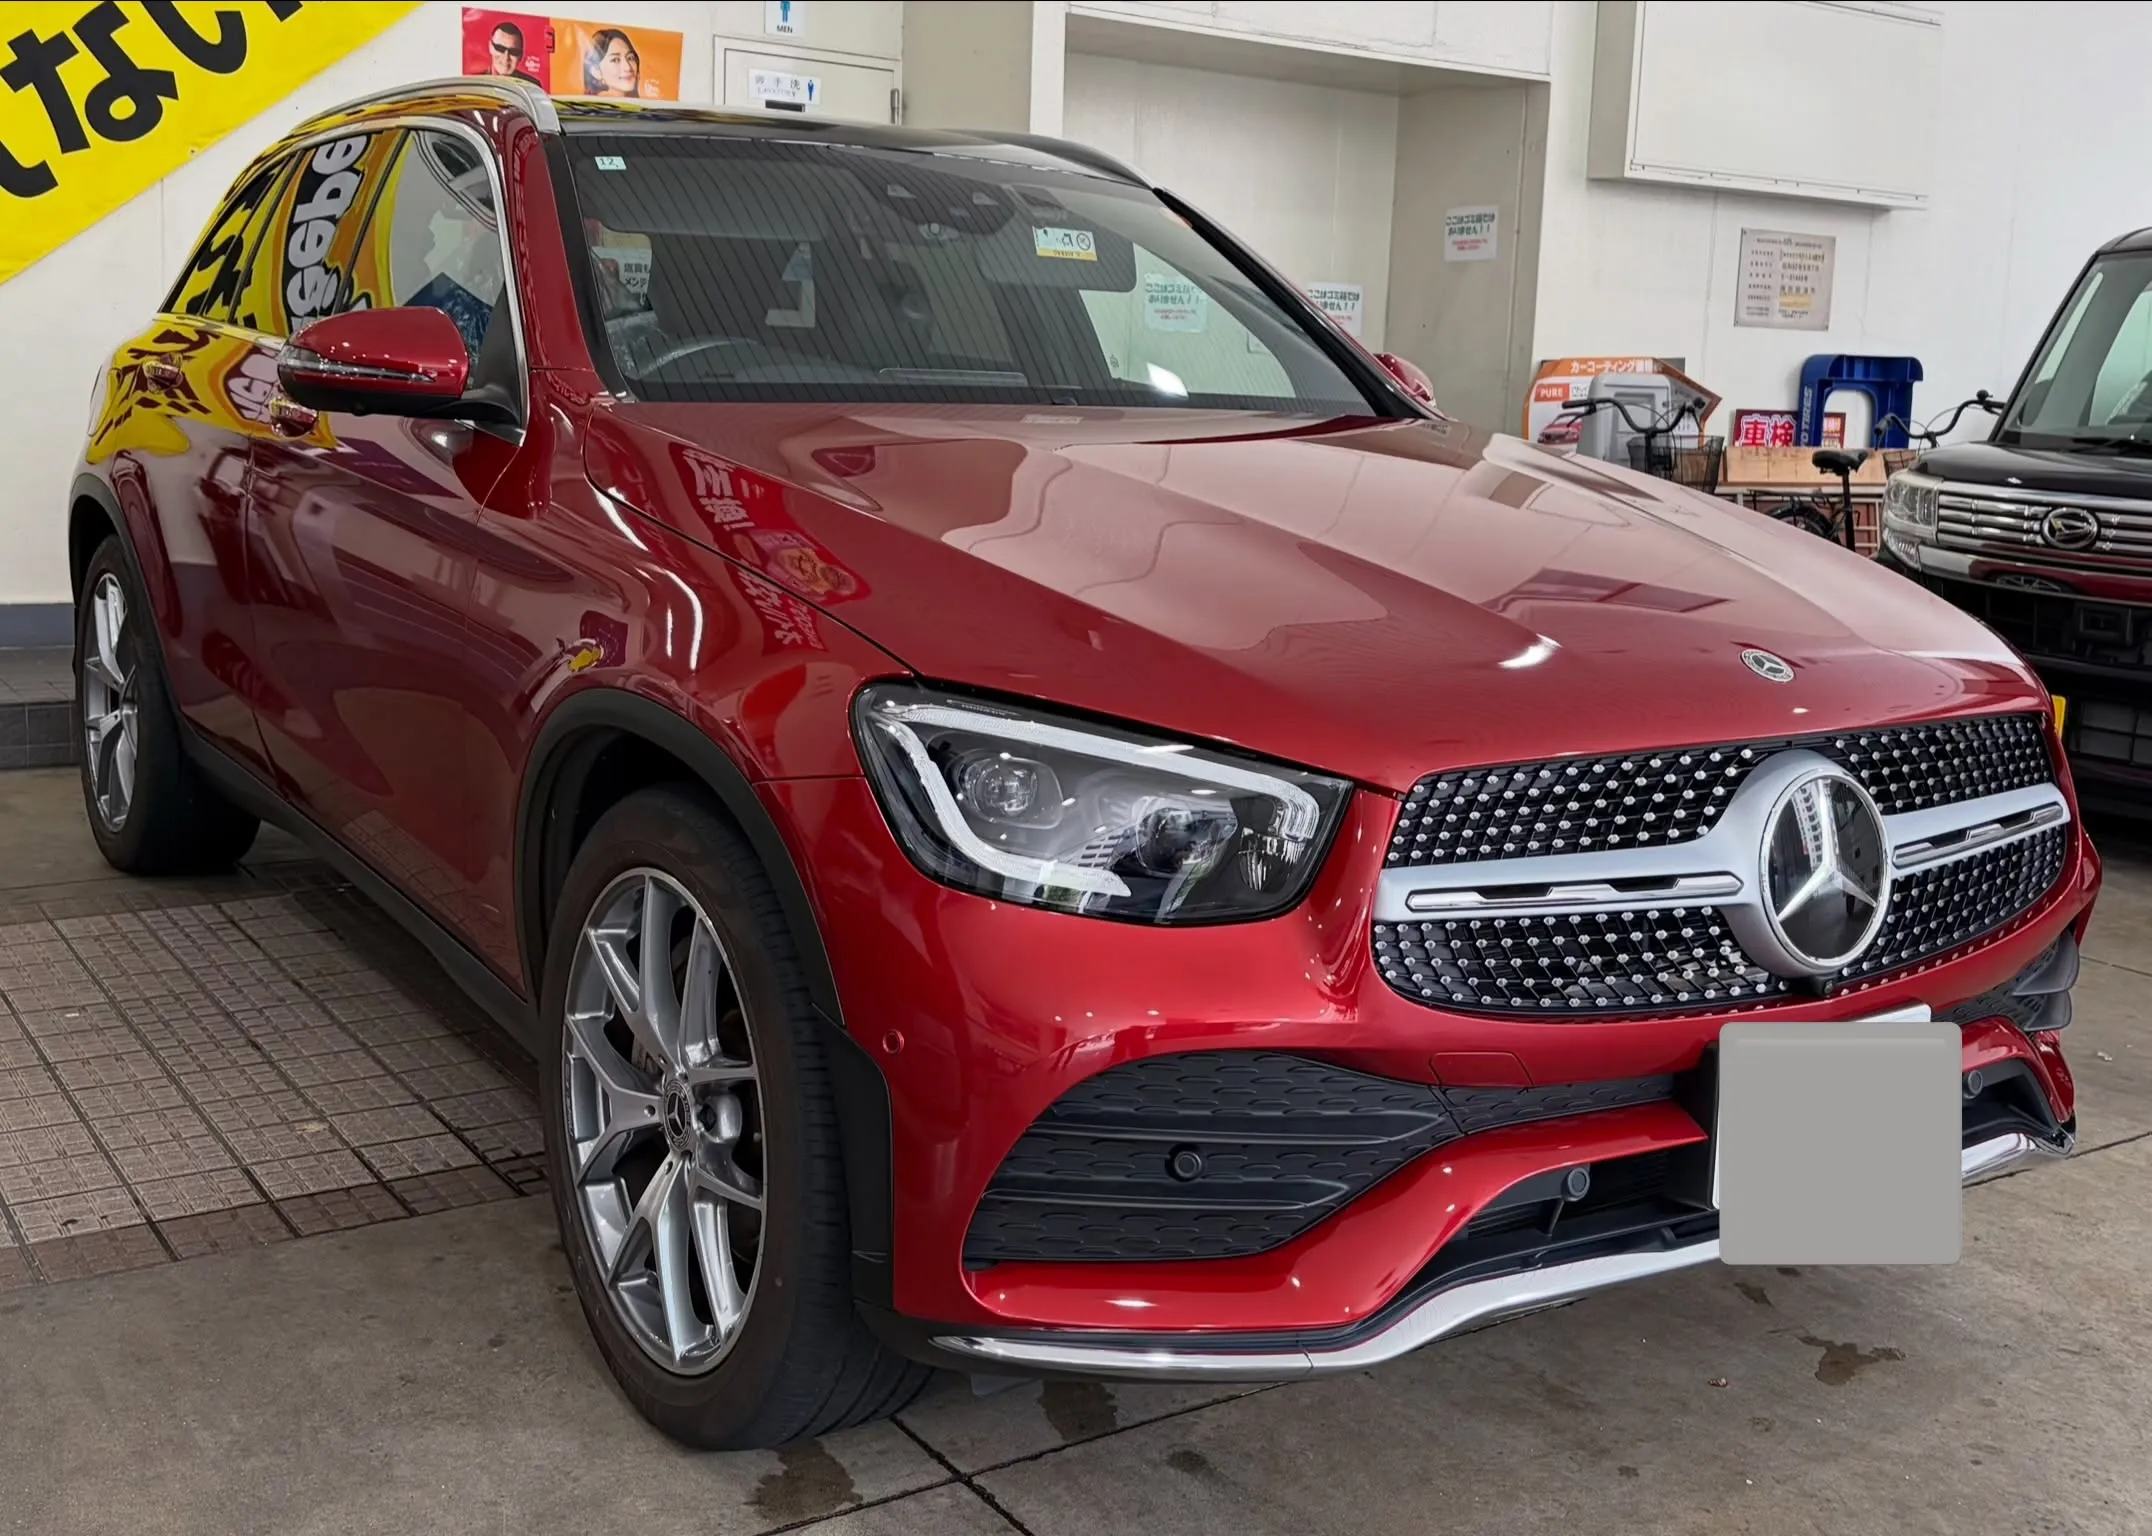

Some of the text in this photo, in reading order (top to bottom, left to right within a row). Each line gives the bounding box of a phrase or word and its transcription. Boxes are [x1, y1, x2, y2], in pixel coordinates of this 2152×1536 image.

[776, 24, 794, 34] MEN
[1540, 388, 1563, 398] PURE
[1741, 415, 1797, 447] 車検
